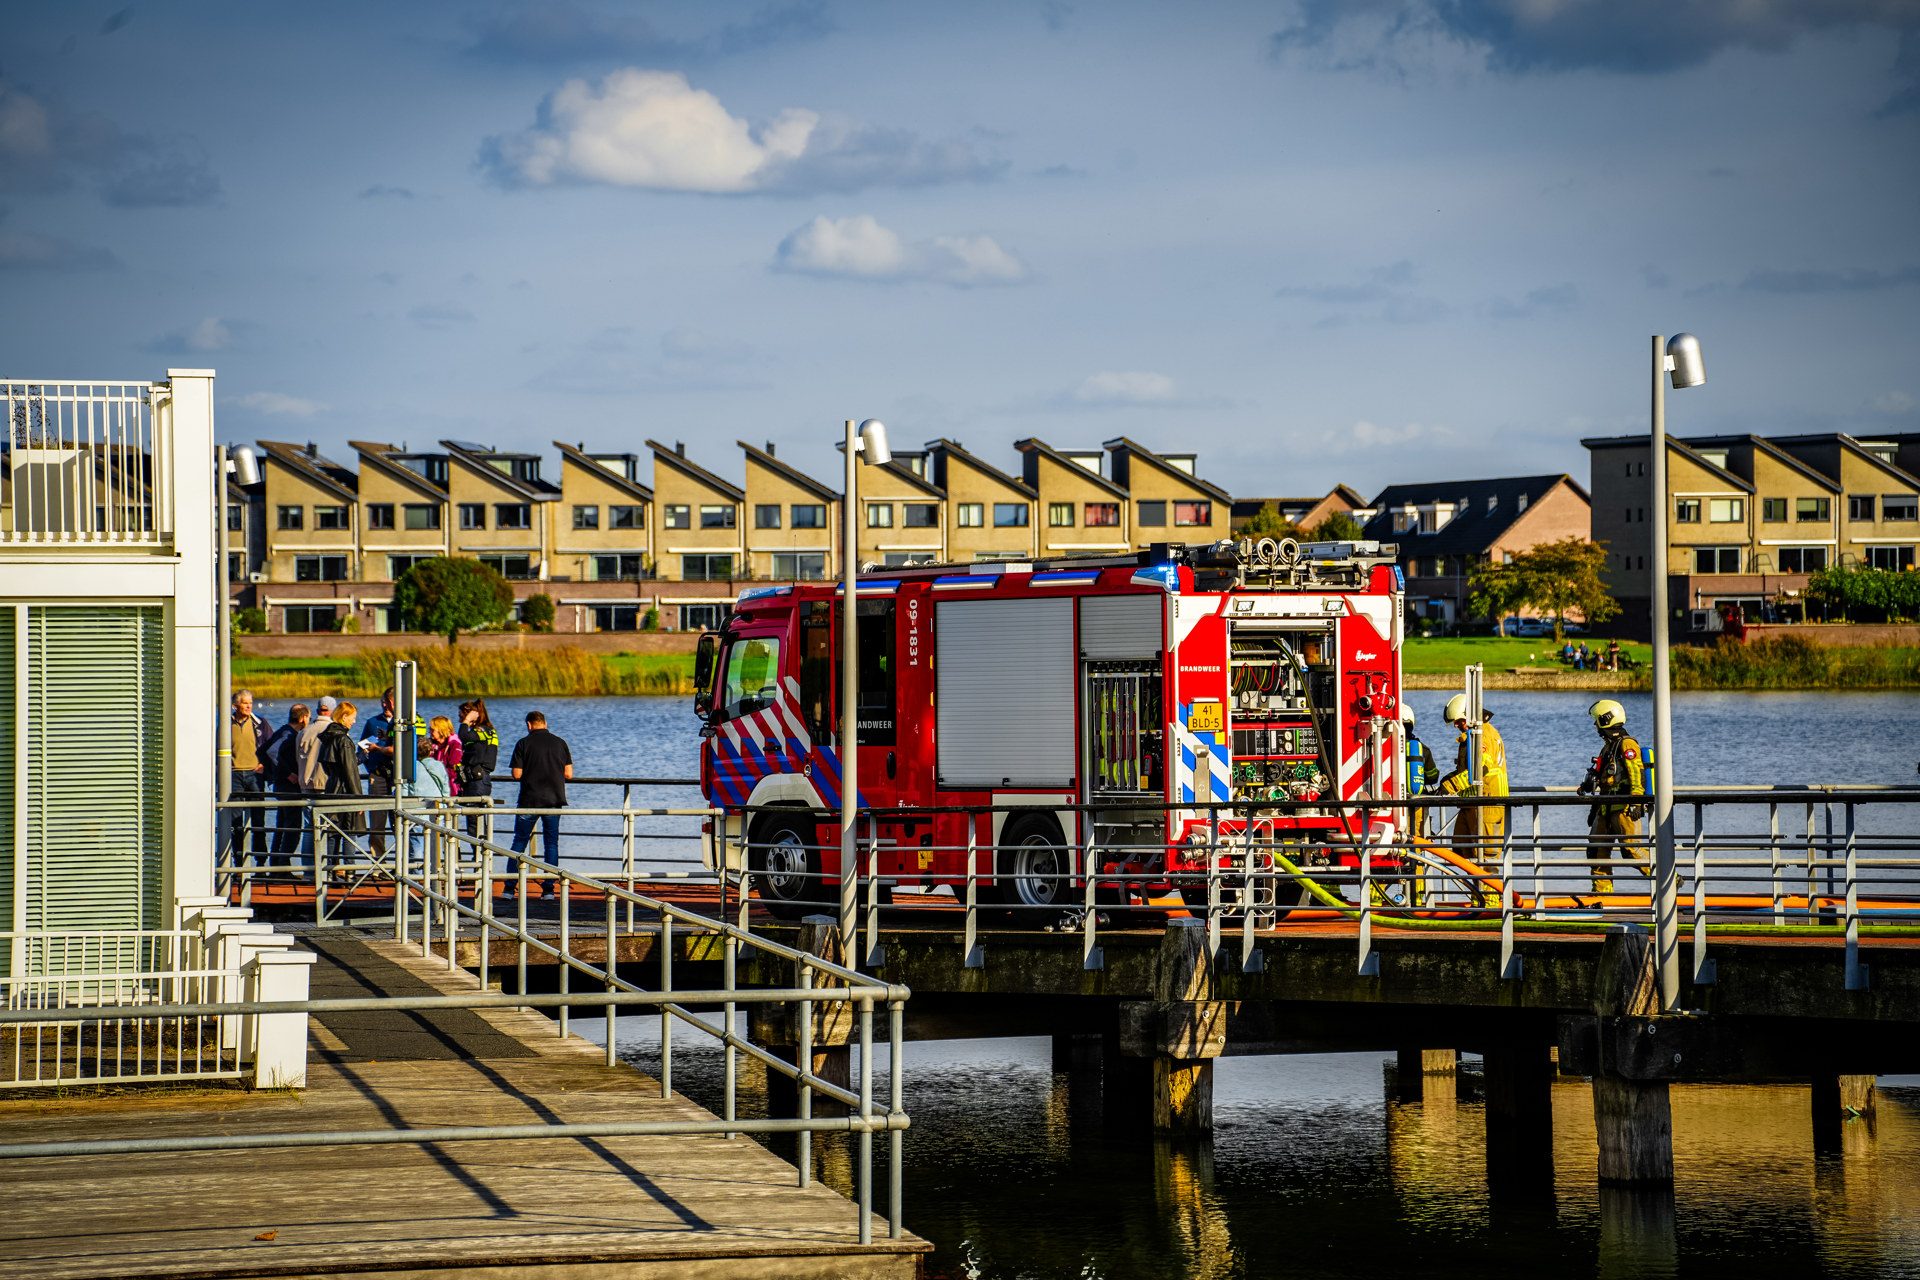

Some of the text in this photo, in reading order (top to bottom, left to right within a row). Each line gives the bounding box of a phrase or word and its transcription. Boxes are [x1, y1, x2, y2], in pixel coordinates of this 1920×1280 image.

[909, 599, 918, 666] 09-1831
[1203, 705, 1212, 715] 41
[857, 720, 893, 729] ANDWEER
[1192, 718, 1220, 728] BLD-5
